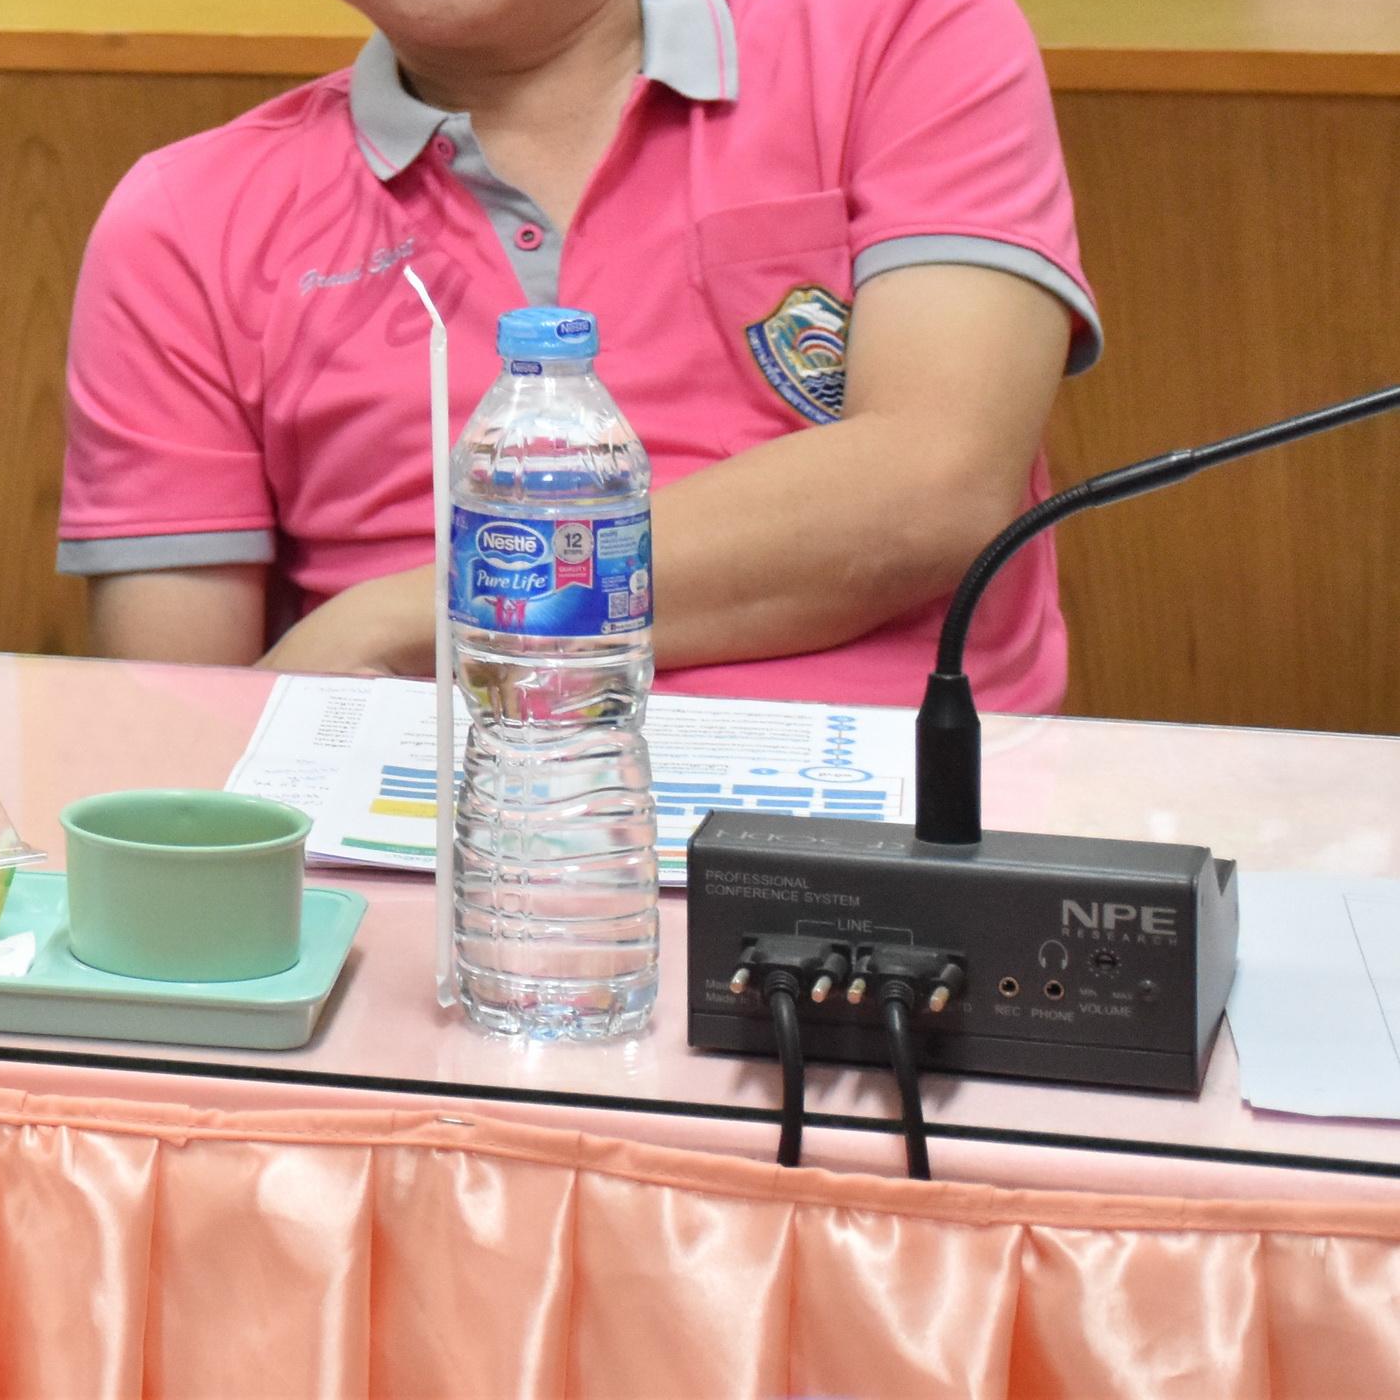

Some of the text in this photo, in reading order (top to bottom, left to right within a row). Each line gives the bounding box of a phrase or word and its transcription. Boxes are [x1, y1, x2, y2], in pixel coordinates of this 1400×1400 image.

[483, 531, 538, 554] Nestlé
[564, 532, 584, 549] 12
[477, 569, 548, 592] Pure Life
[705, 869, 810, 890] PROFESSIONAL
[704, 883, 861, 908] CONFERENCE SYSTEM
[837, 917, 874, 933] LINE
[1061, 899, 1178, 936] NPE
[1061, 927, 1178, 947] RESEARCH
[994, 1004, 1076, 1023] REC PHONE
[1078, 1002, 1135, 1018] VOLUME
